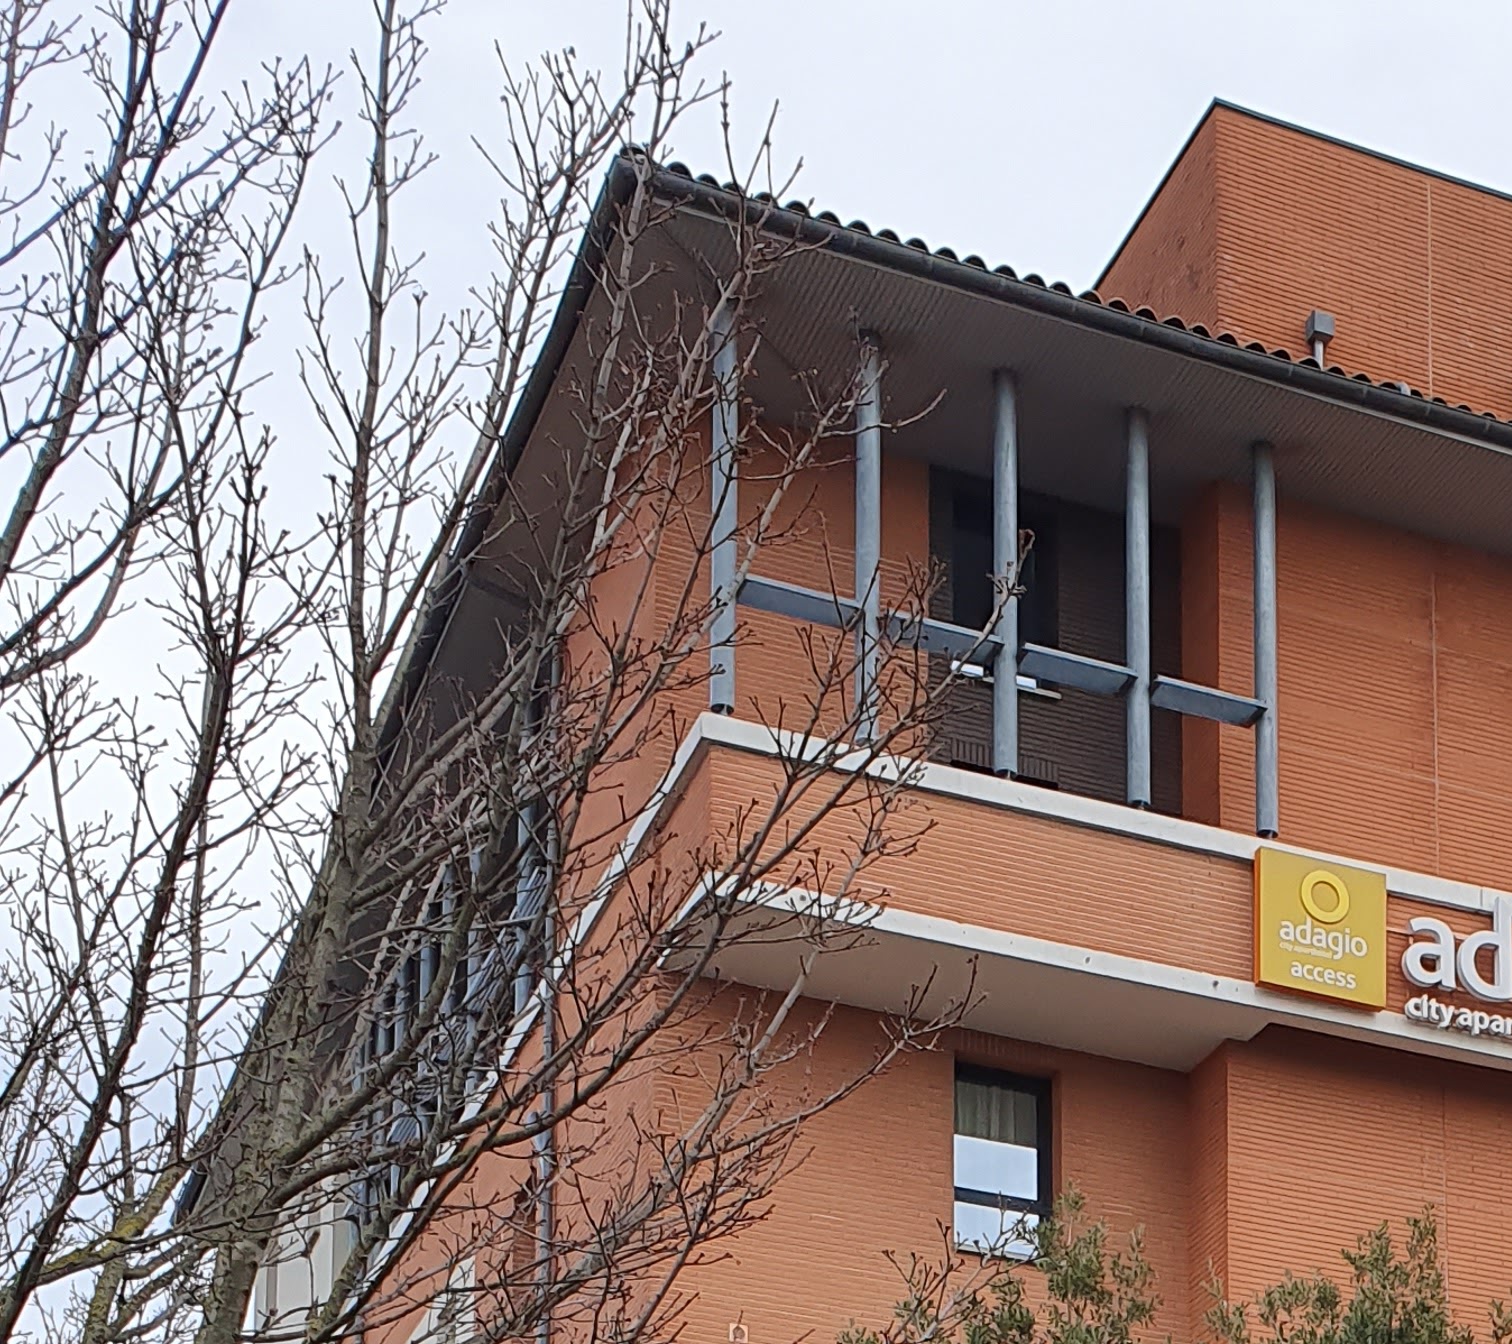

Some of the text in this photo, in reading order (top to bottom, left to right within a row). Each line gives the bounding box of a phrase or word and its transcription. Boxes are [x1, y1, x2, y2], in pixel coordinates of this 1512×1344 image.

[1279, 913, 1368, 960] adagio
[1290, 960, 1357, 990] access
[1405, 993, 1455, 1030] city
